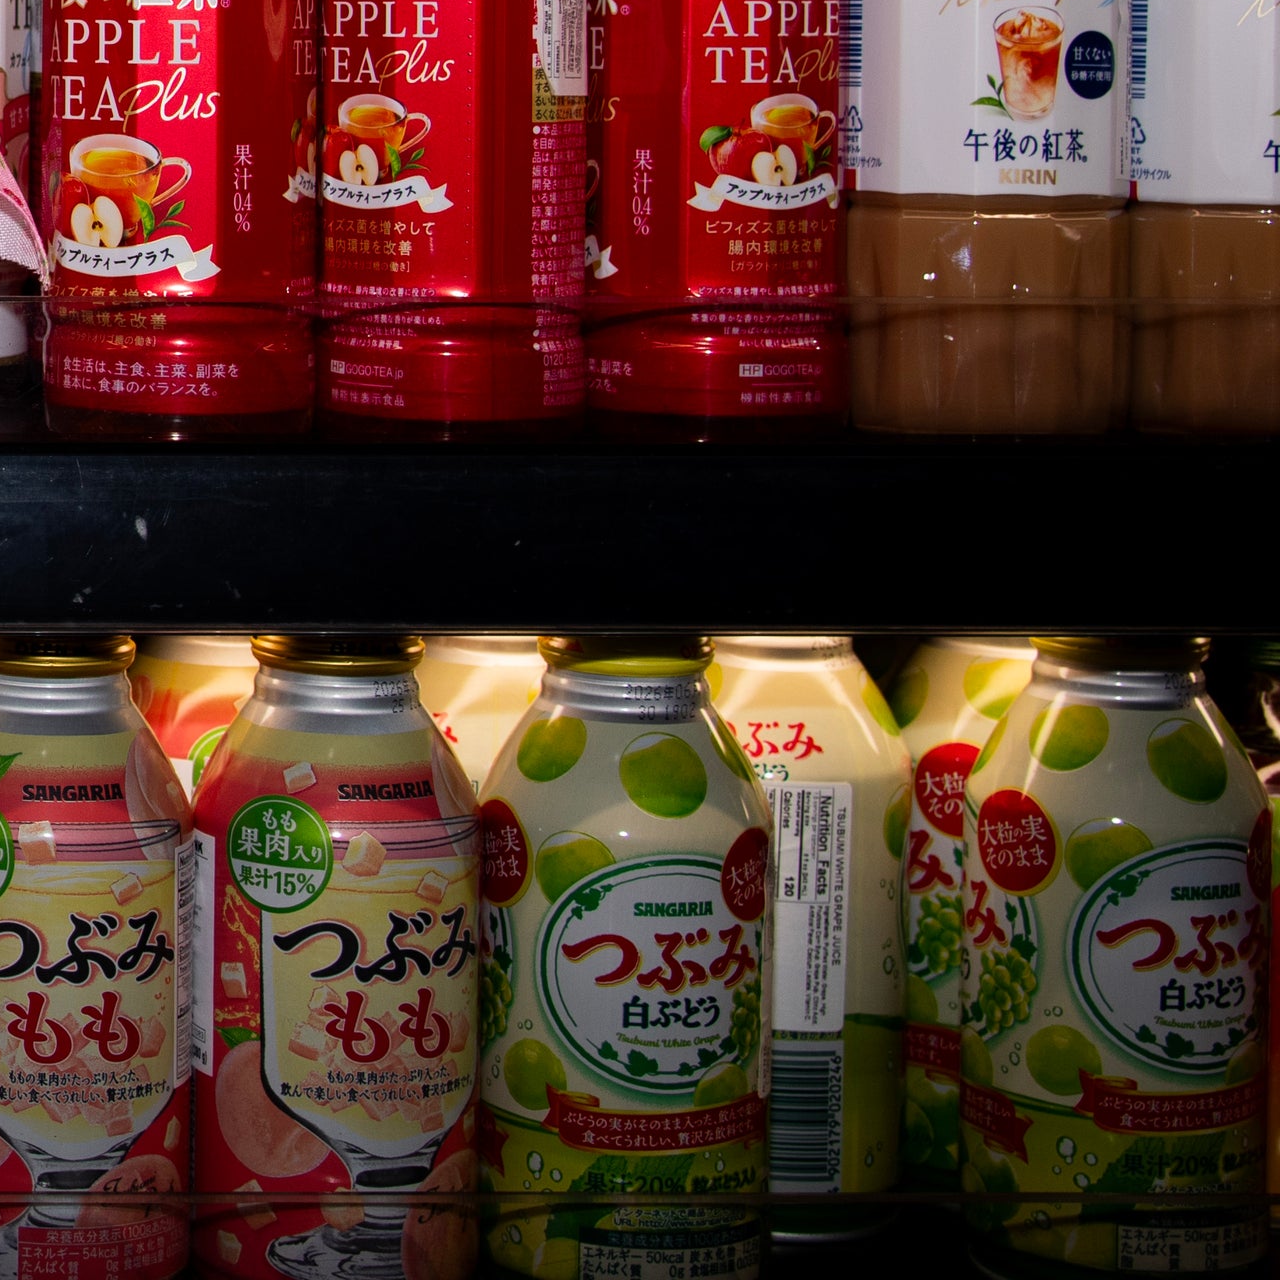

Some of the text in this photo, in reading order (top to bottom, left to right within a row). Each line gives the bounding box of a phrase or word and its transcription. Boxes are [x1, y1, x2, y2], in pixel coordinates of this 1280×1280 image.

[703, 0, 839, 37] APPLE
[50, 19, 201, 65] APPLE
[705, 47, 798, 84] TEA
[964, 129, 1083, 162] 午後の紅茶
[727, 182, 826, 205] アップルティープラス
[999, 168, 1056, 185] KIRIN
[22, 782, 123, 802] SANGARIA
[337, 780, 433, 802] SANGARIA
[237, 827, 322, 868] 果肉入り
[816, 794, 832, 896] Nutrition Facts
[238, 865, 316, 897] 果汁15%
[633, 900, 713, 918] SANGARIA
[272, 907, 476, 985] つぶみ
[561, 924, 754, 995] つぶみ
[6, 991, 142, 1065] もも
[324, 987, 450, 1065] もも
[622, 996, 721, 1031] 白ぶどう
